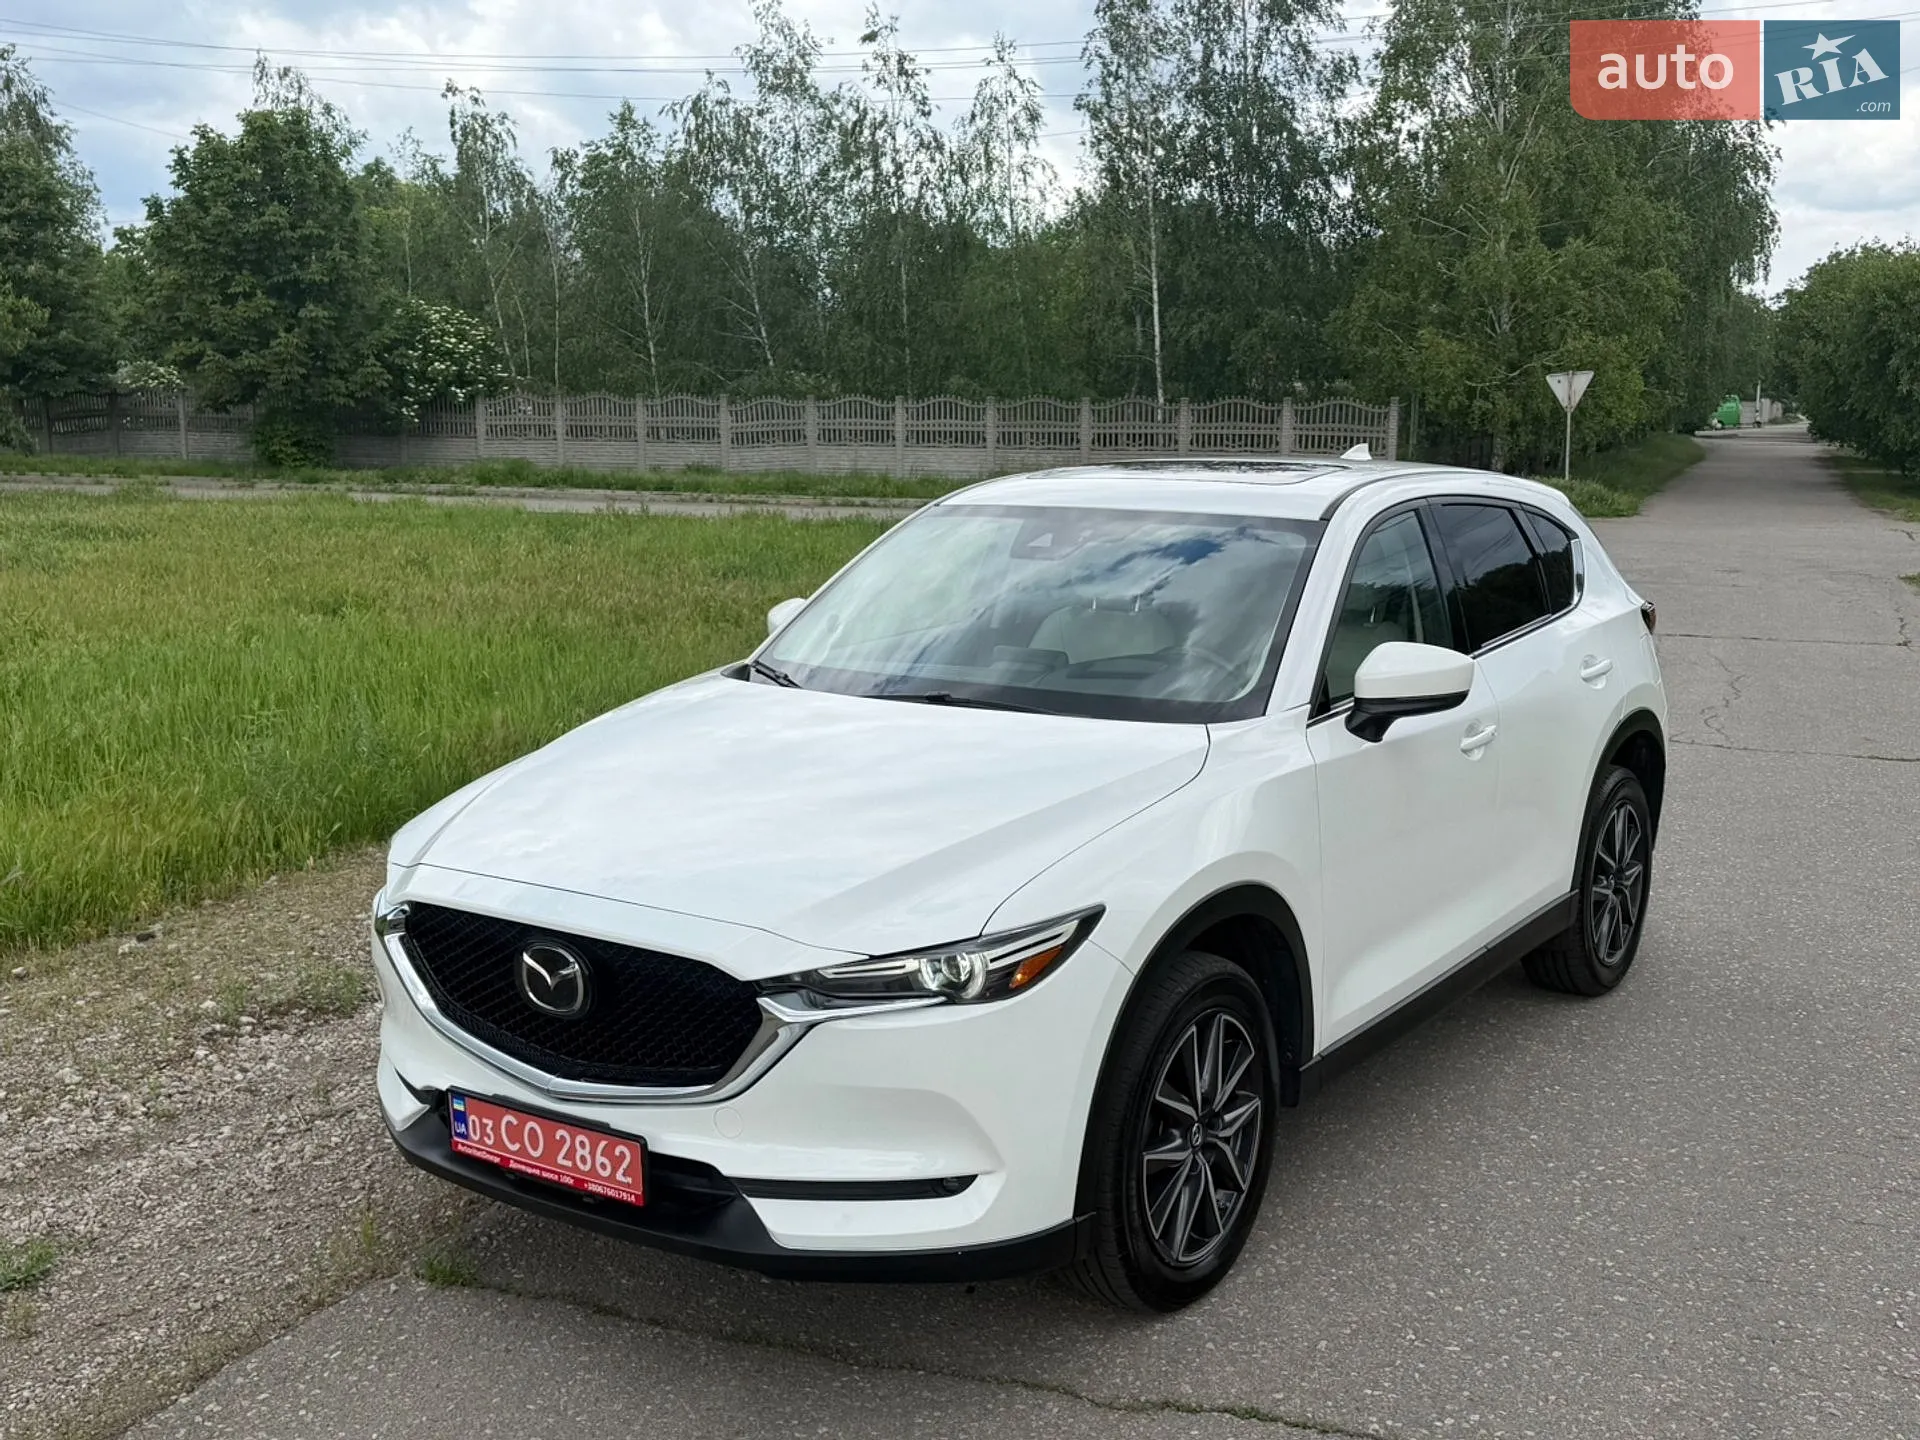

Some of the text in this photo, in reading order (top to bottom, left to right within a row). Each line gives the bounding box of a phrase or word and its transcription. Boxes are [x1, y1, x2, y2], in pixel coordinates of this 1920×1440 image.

[454, 1119, 468, 1136] UA
[469, 1114, 633, 1185] 03 CO 2862
